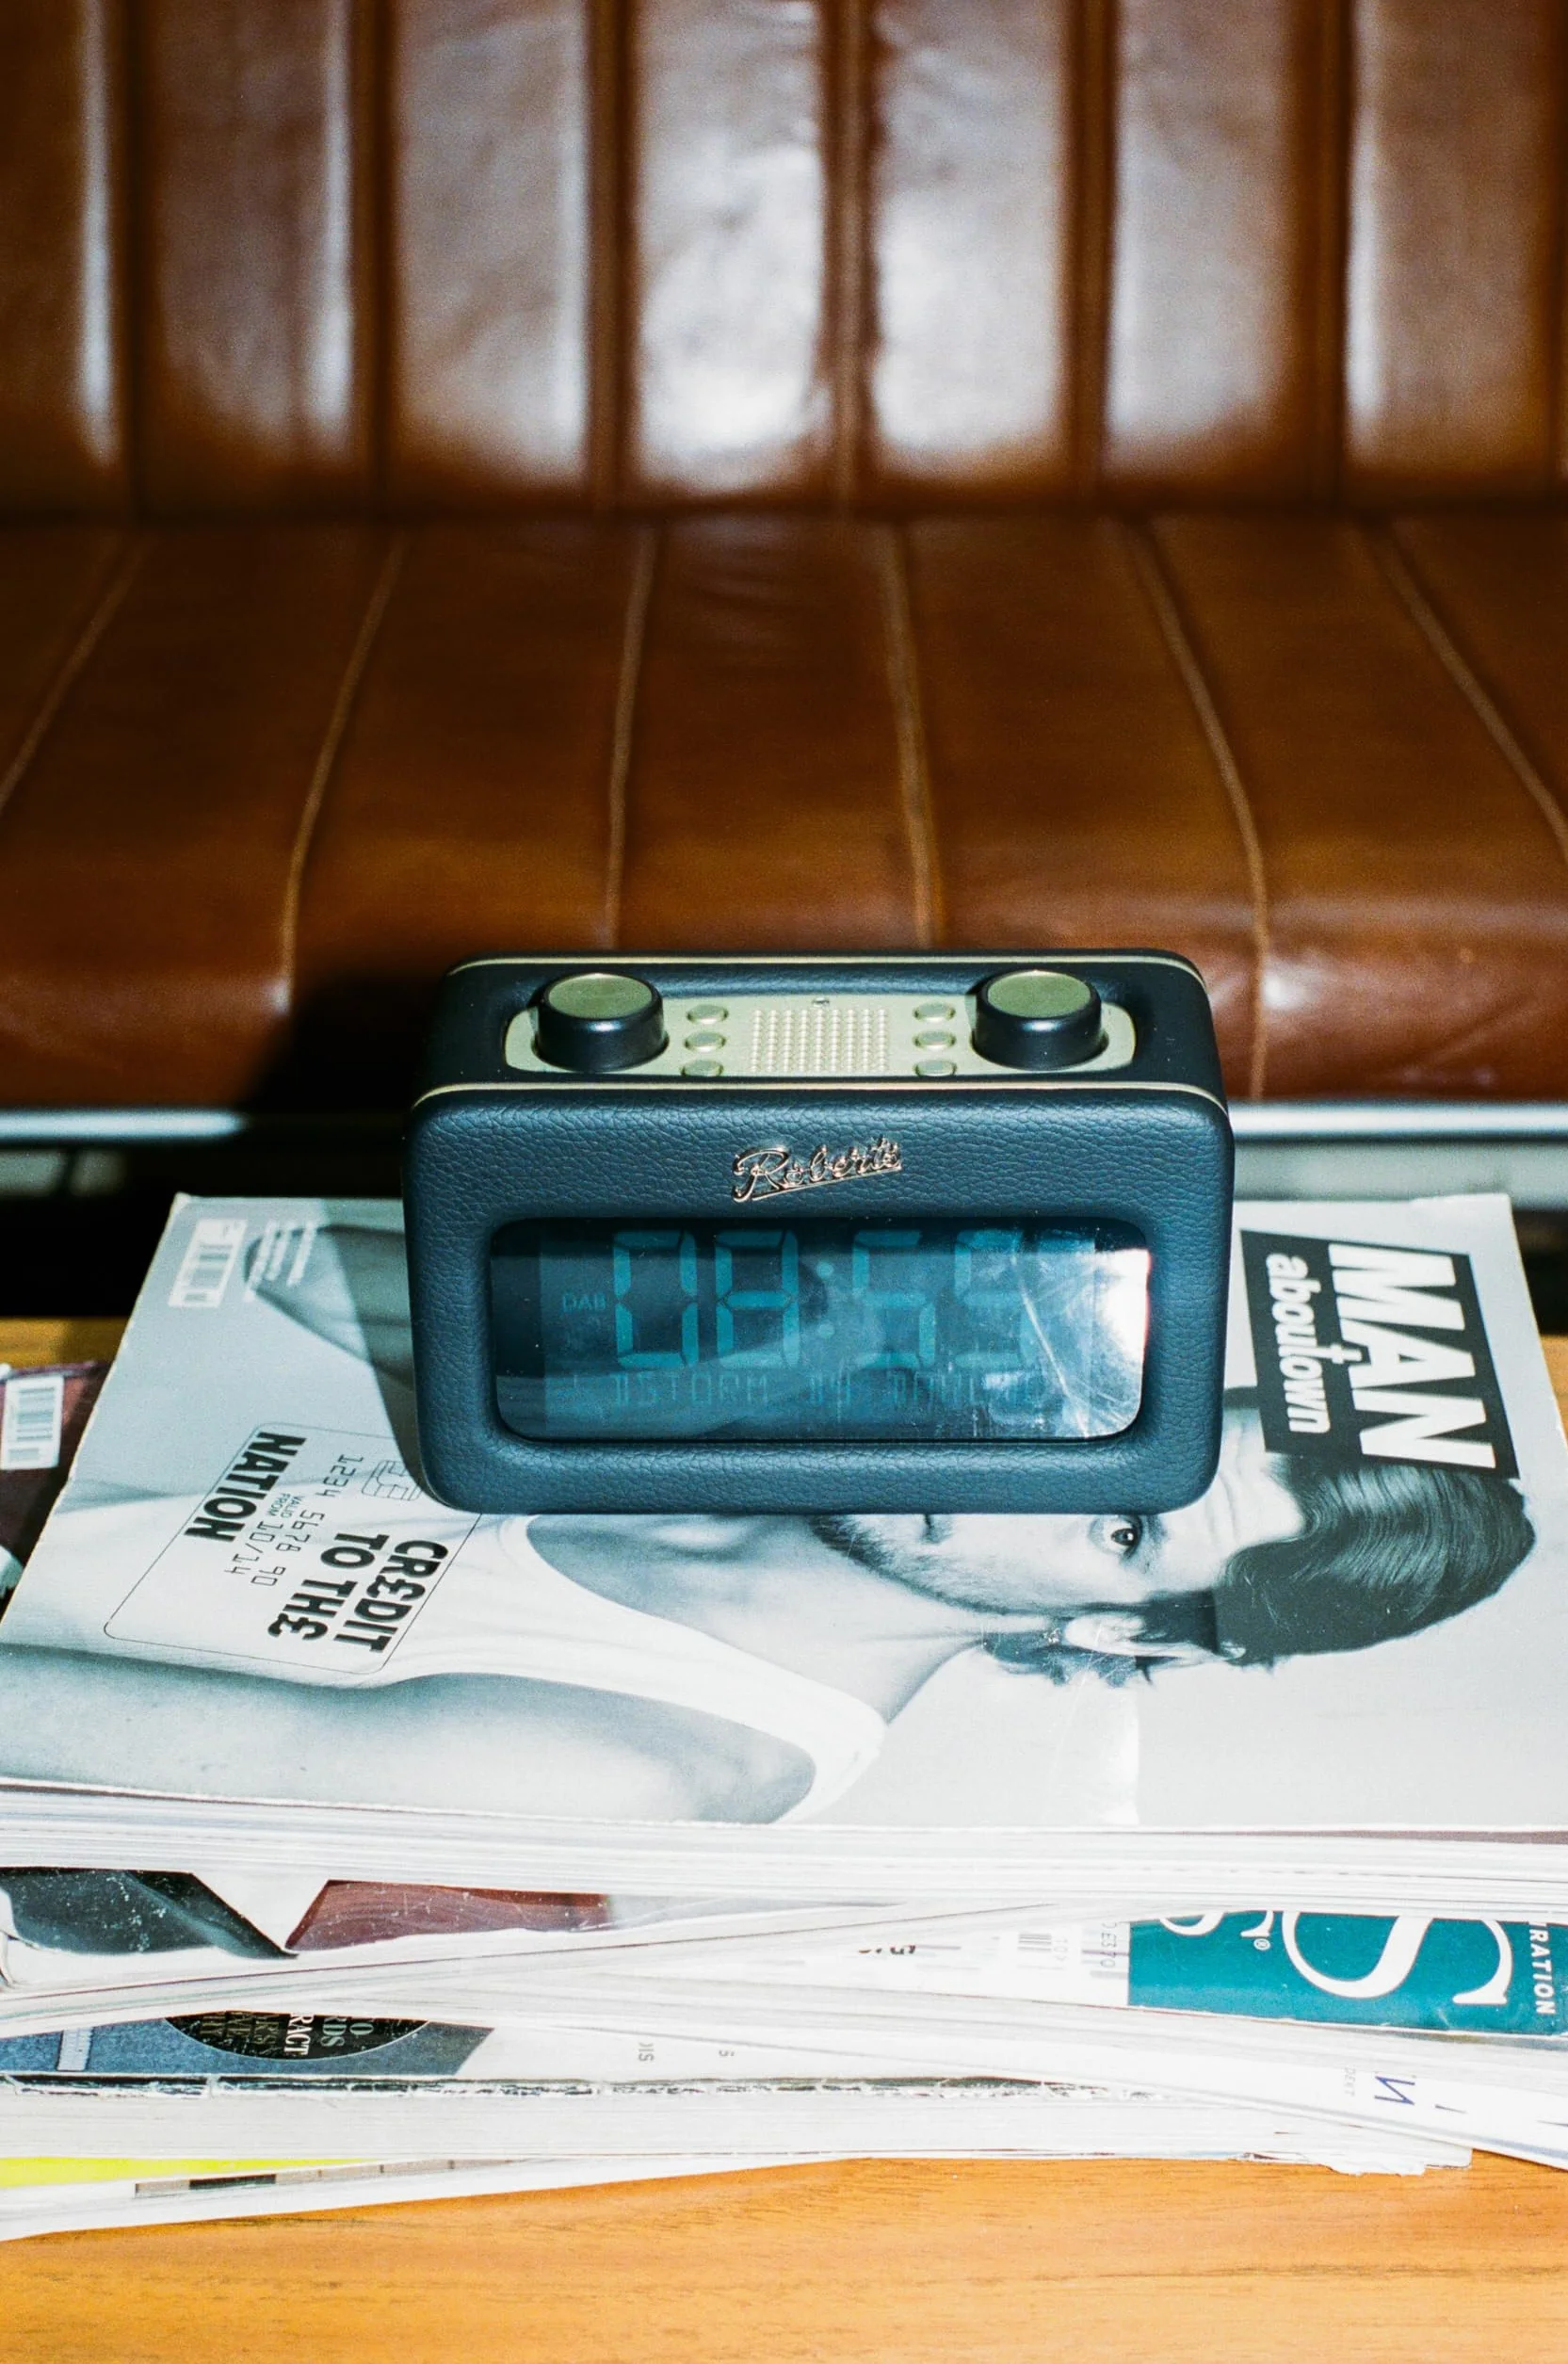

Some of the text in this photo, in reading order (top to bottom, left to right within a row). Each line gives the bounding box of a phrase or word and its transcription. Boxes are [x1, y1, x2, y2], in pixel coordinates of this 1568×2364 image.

[733, 1134, 903, 1203] Roberts
[1328, 1243, 1496, 1469] MAN
[184, 1432, 307, 1543] NATION
[251, 1453, 364, 1587] 1234 5678 90
[280, 1495, 303, 1518] VALID
[224, 1493, 291, 1575] FROM 10/14
[320, 1533, 390, 1569] TO
